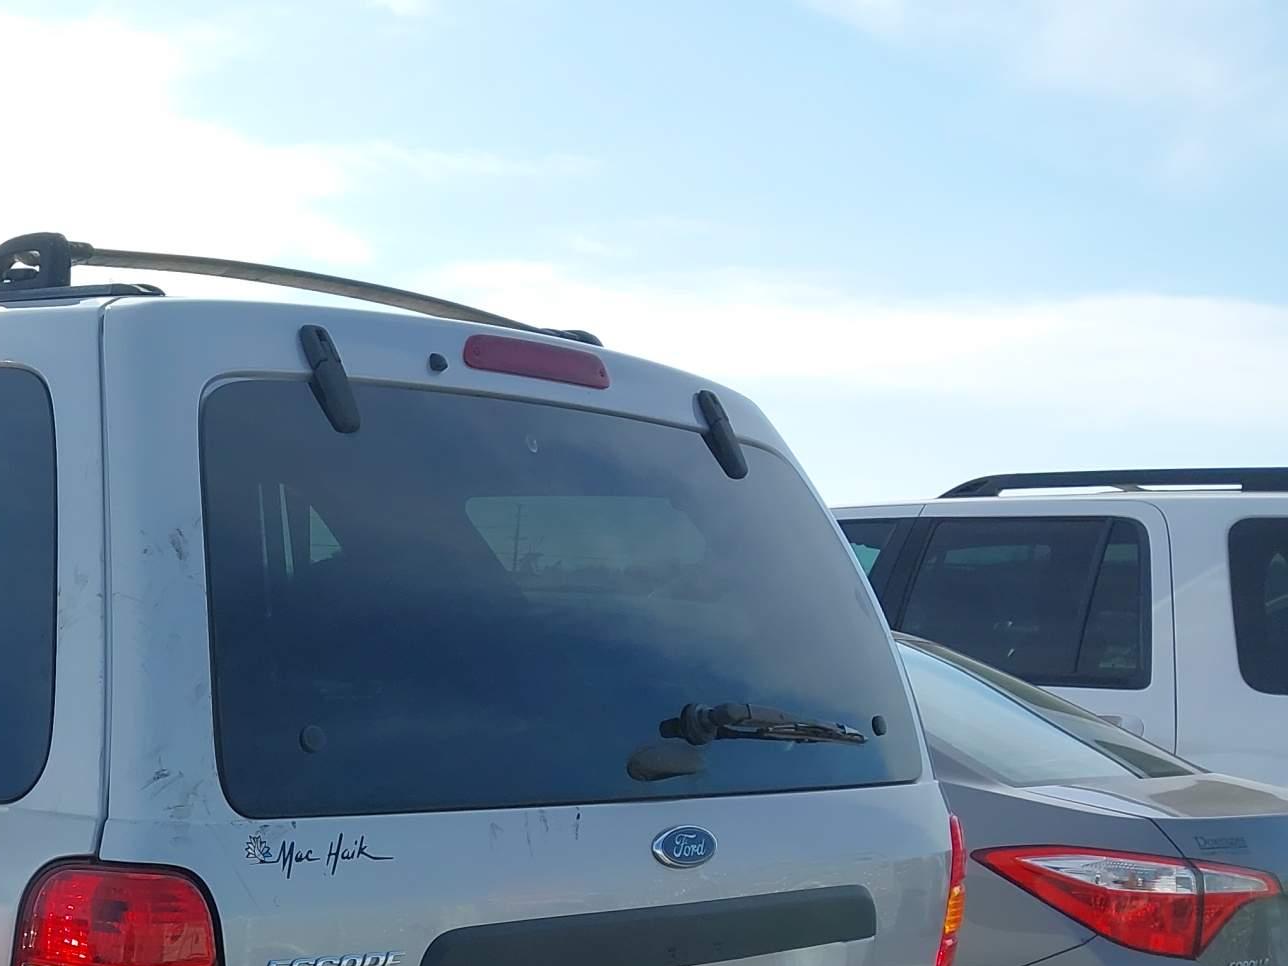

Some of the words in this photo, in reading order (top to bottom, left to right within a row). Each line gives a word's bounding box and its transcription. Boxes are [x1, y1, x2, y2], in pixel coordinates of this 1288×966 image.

[275, 840, 321, 879] Mac
[326, 832, 394, 876] Haik
[673, 833, 706, 858] Ford
